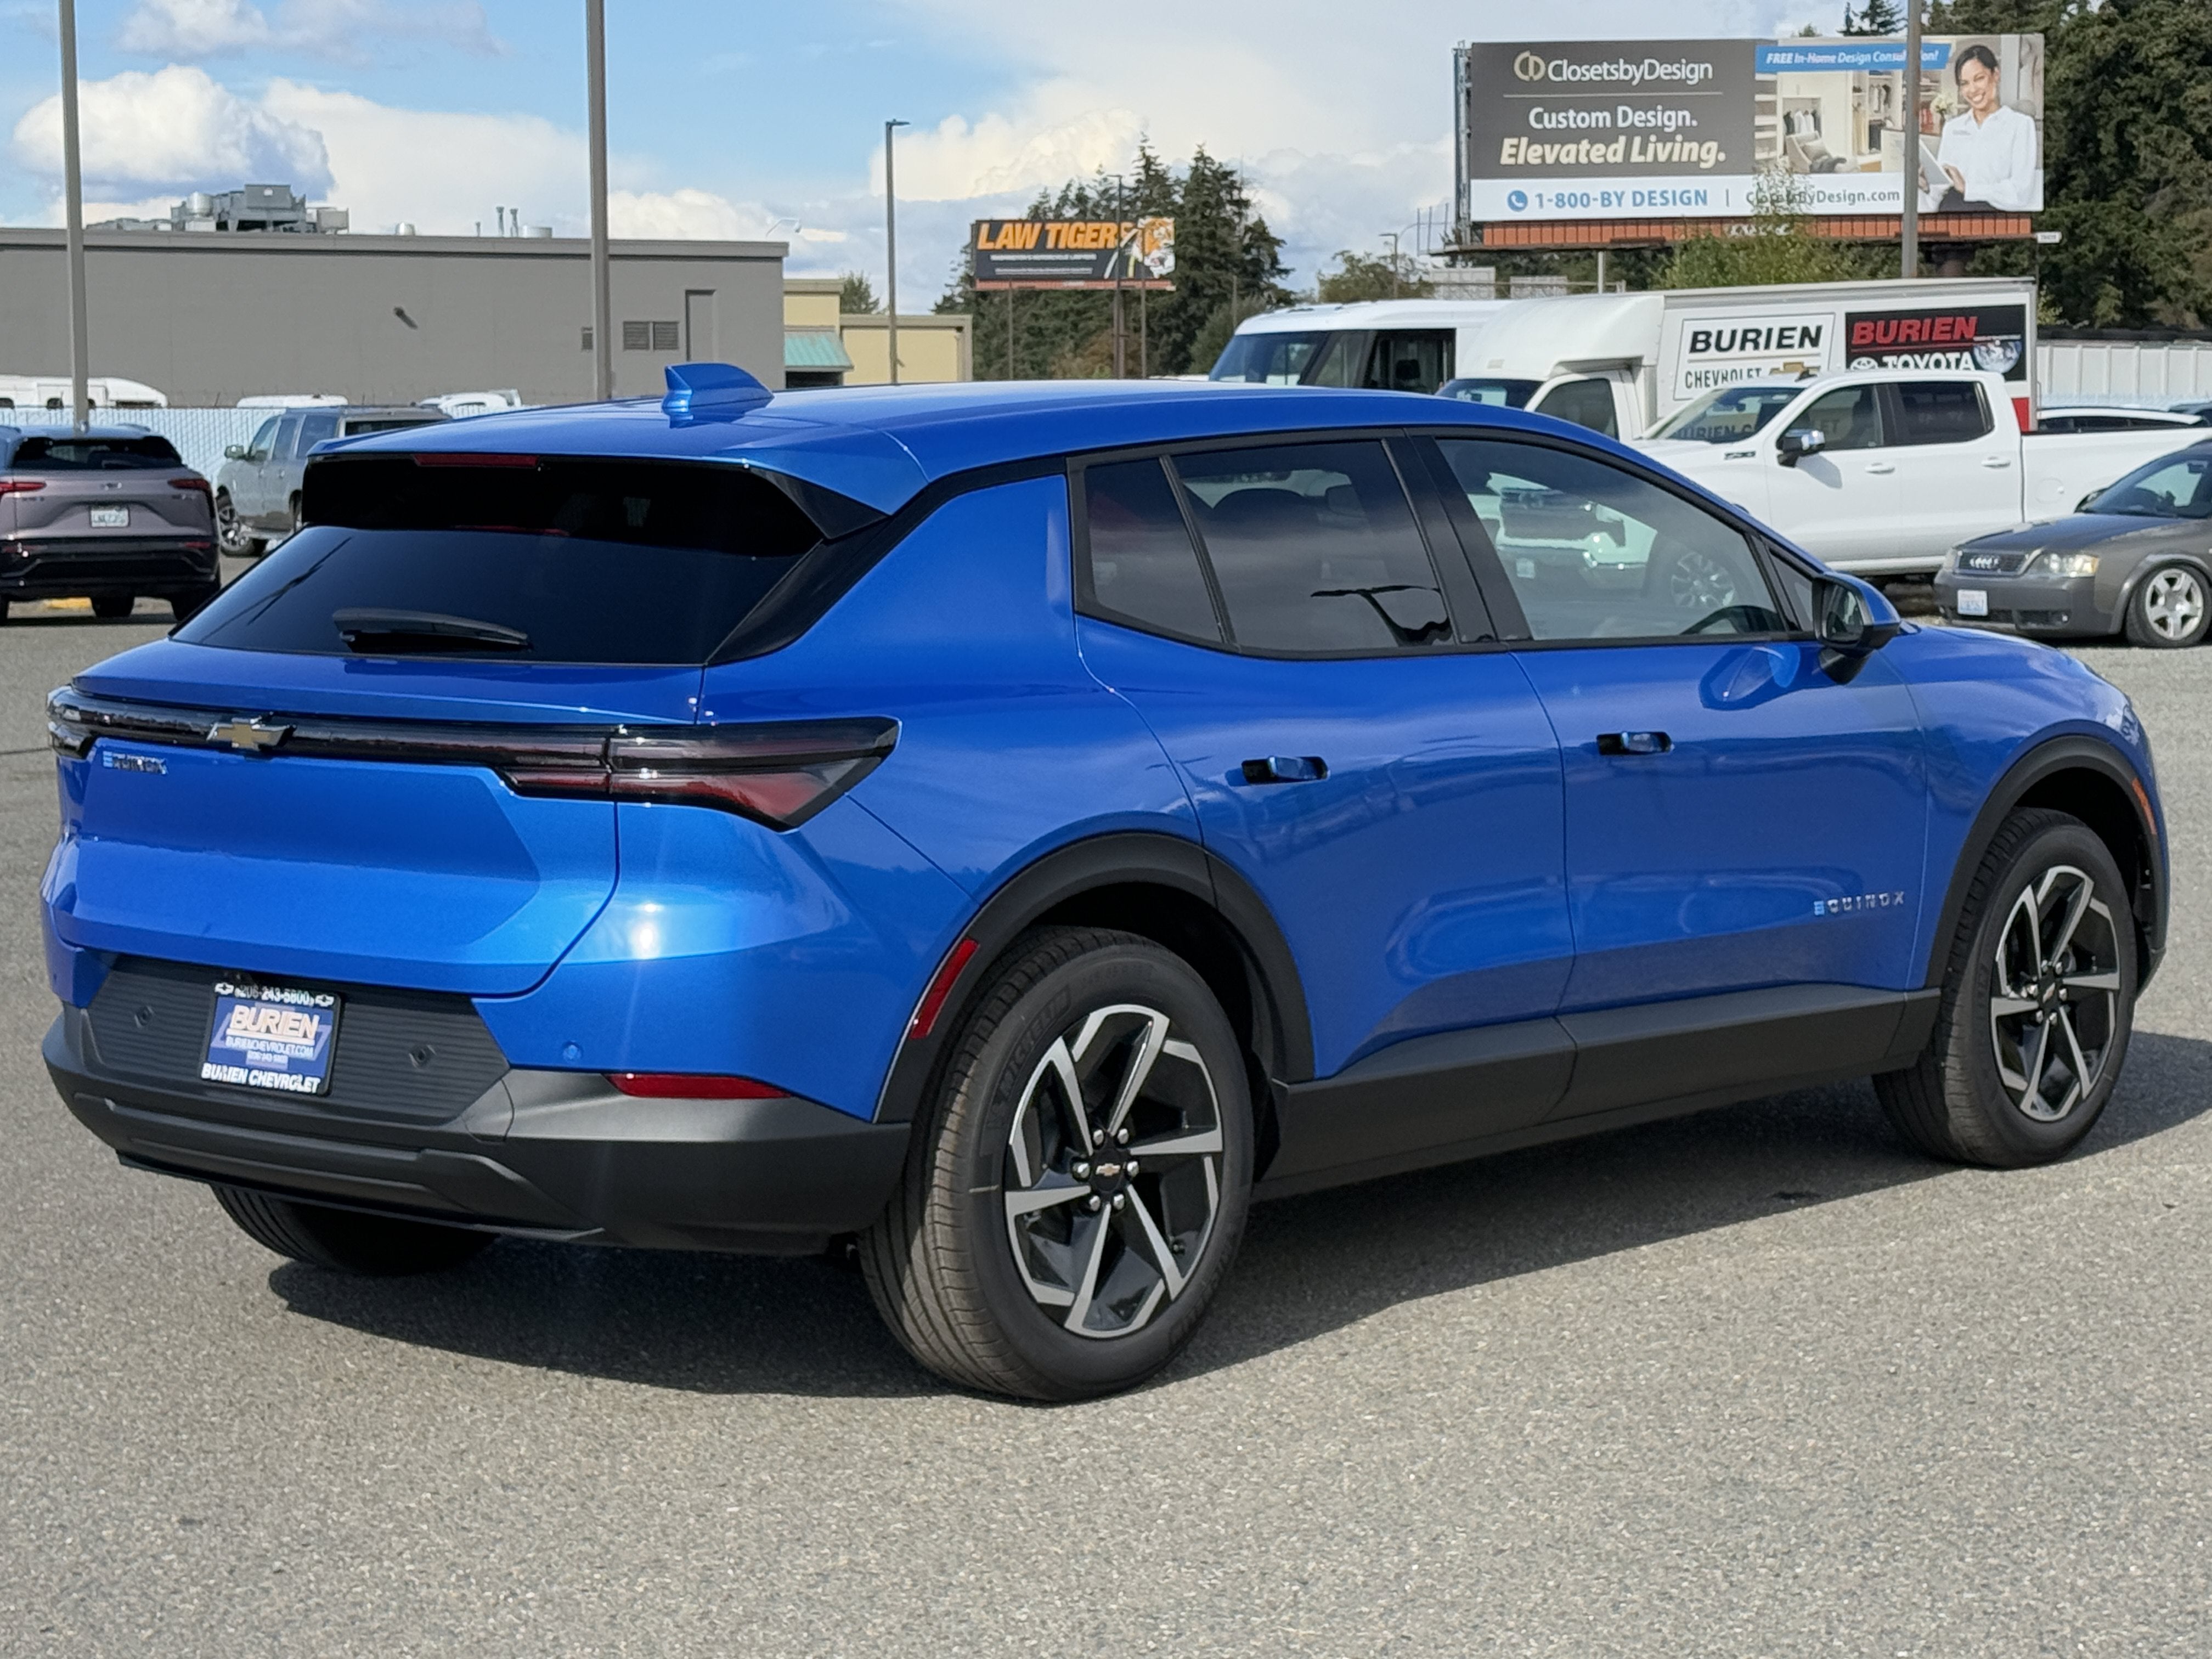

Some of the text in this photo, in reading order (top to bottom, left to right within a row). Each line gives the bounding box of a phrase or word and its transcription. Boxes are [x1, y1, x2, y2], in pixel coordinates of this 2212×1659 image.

[1766, 49, 1939, 65] FREE In-Home Design Consulon!
[1547, 58, 1713, 86] ClosetsbyDesign
[1528, 105, 1699, 132] Custom Design.
[1499, 134, 1726, 168] Elevated Living.
[1535, 189, 1708, 209] 1-800-BY DESIGN
[977, 222, 1042, 250] LAW
[1689, 325, 1823, 354] BURIEN
[1851, 317, 1978, 345] BURIEN
[1882, 352, 1976, 370] TOYOTA
[1813, 891, 1905, 916] EQUINOX
[229, 1005, 320, 1040] BURIEN
[201, 1063, 321, 1093] BURIEN CHEVROLET
